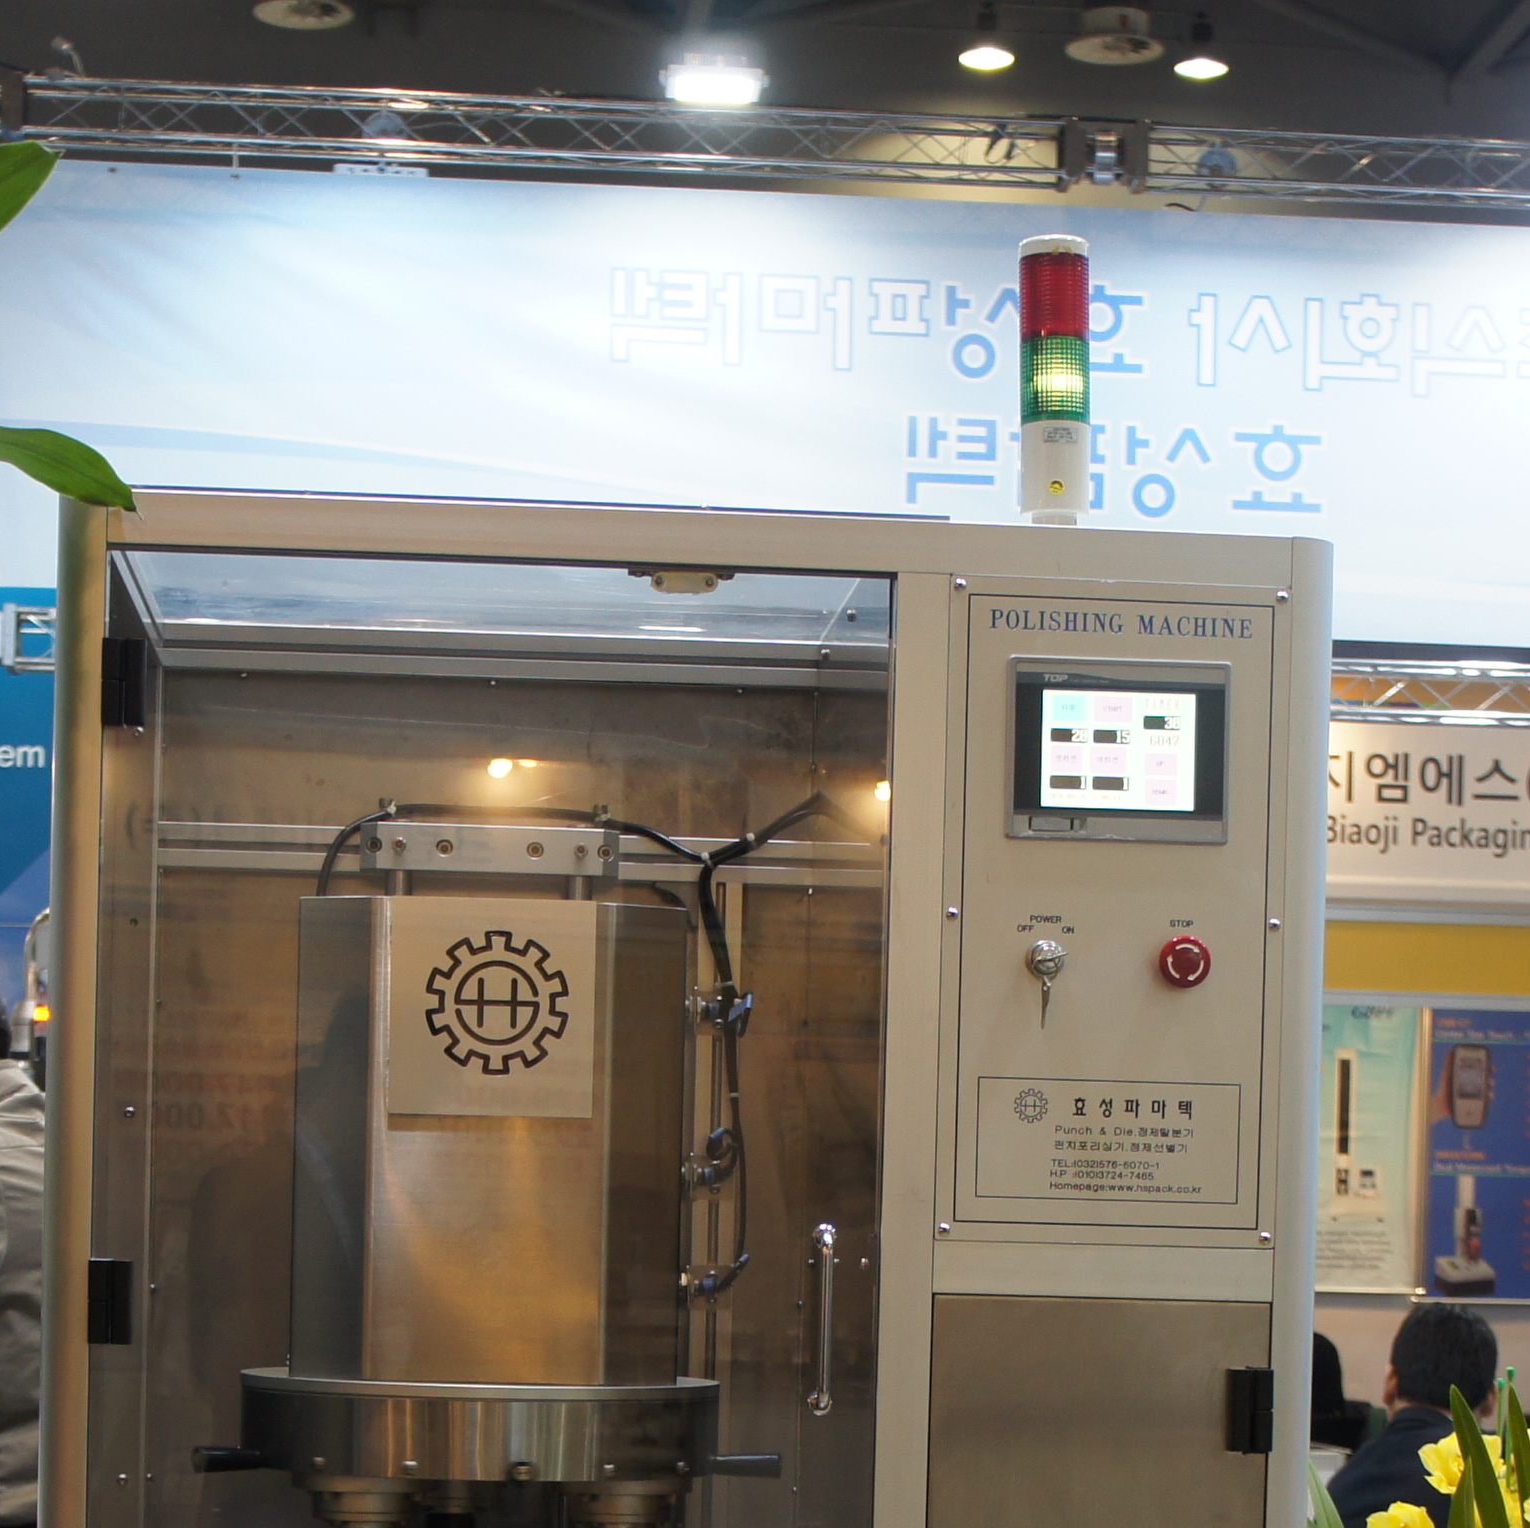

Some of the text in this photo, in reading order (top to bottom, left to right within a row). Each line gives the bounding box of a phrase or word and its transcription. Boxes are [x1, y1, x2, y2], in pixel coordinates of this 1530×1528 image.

[990, 609, 1253, 639] POLISHING MACHINE
[1145, 698, 1180, 710] TIMER
[1030, 915, 1062, 924] POWER
[1170, 919, 1193, 928] STOP
[1017, 924, 1075, 934] OFF ON
[1054, 1125, 1093, 1136] Punch
[1099, 1127, 1107, 1136] &
